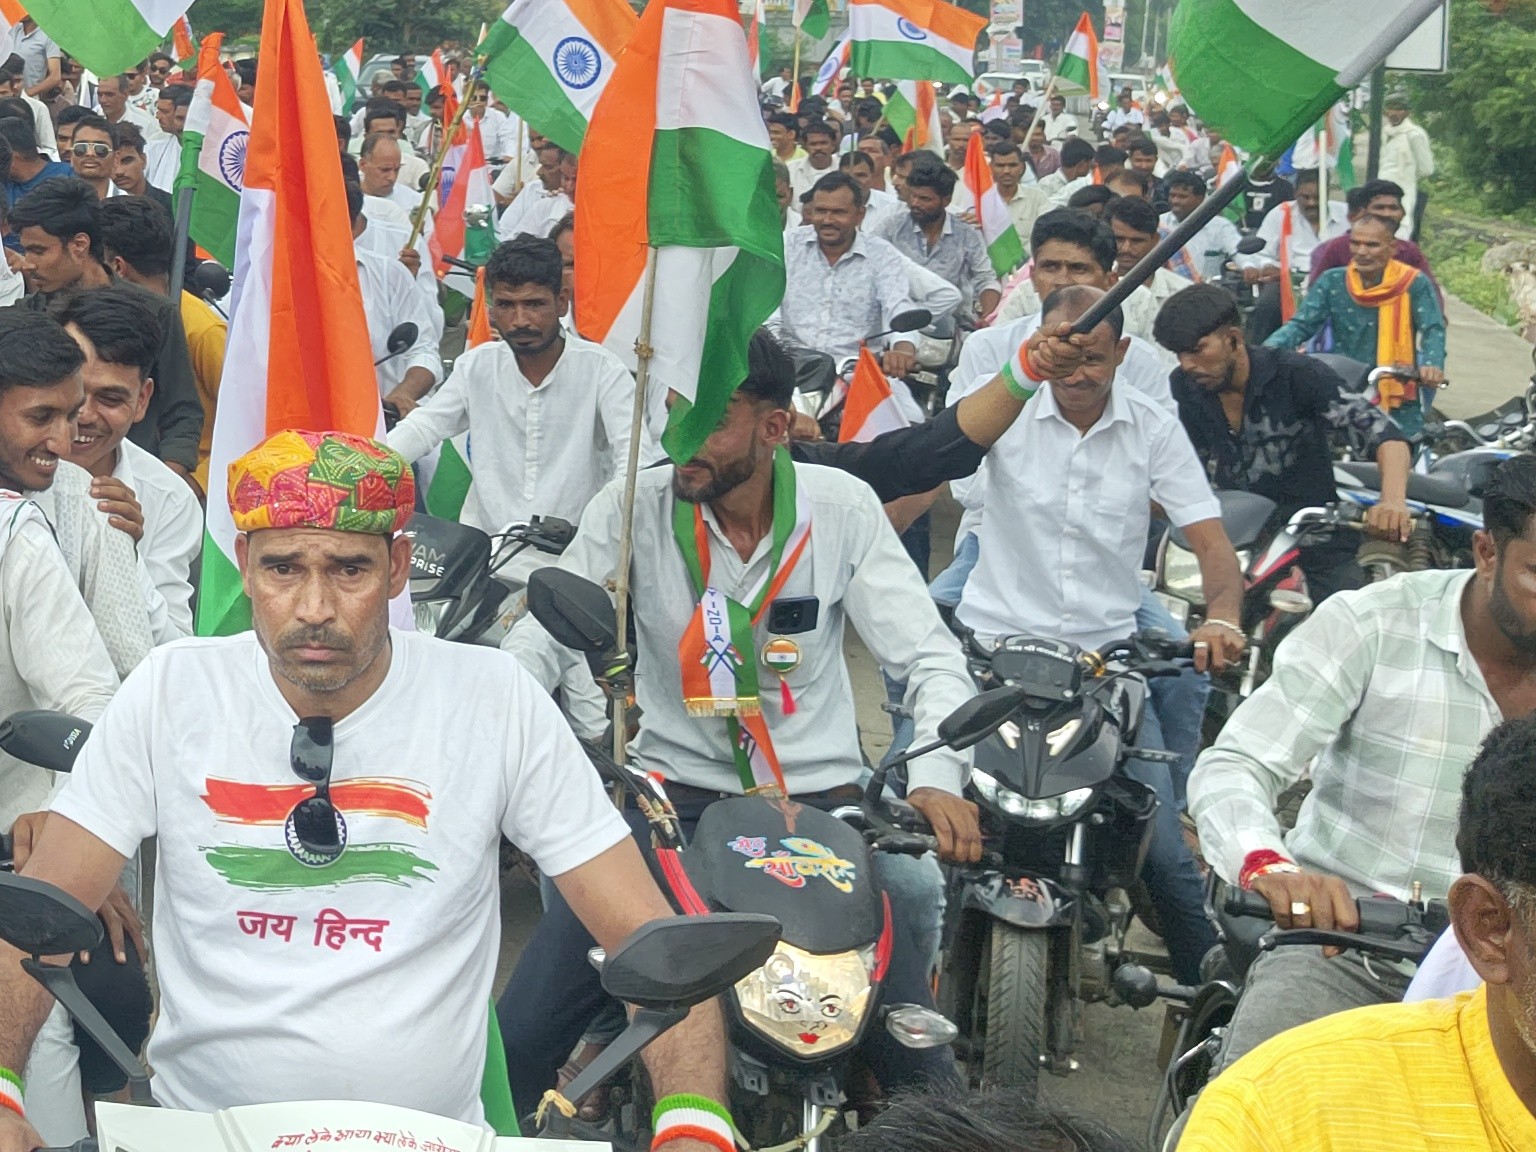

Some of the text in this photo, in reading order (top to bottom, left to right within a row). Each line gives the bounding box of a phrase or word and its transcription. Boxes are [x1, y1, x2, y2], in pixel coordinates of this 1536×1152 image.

[706, 601, 725, 643] INDIA
[236, 907, 391, 952] जय हिन्द
